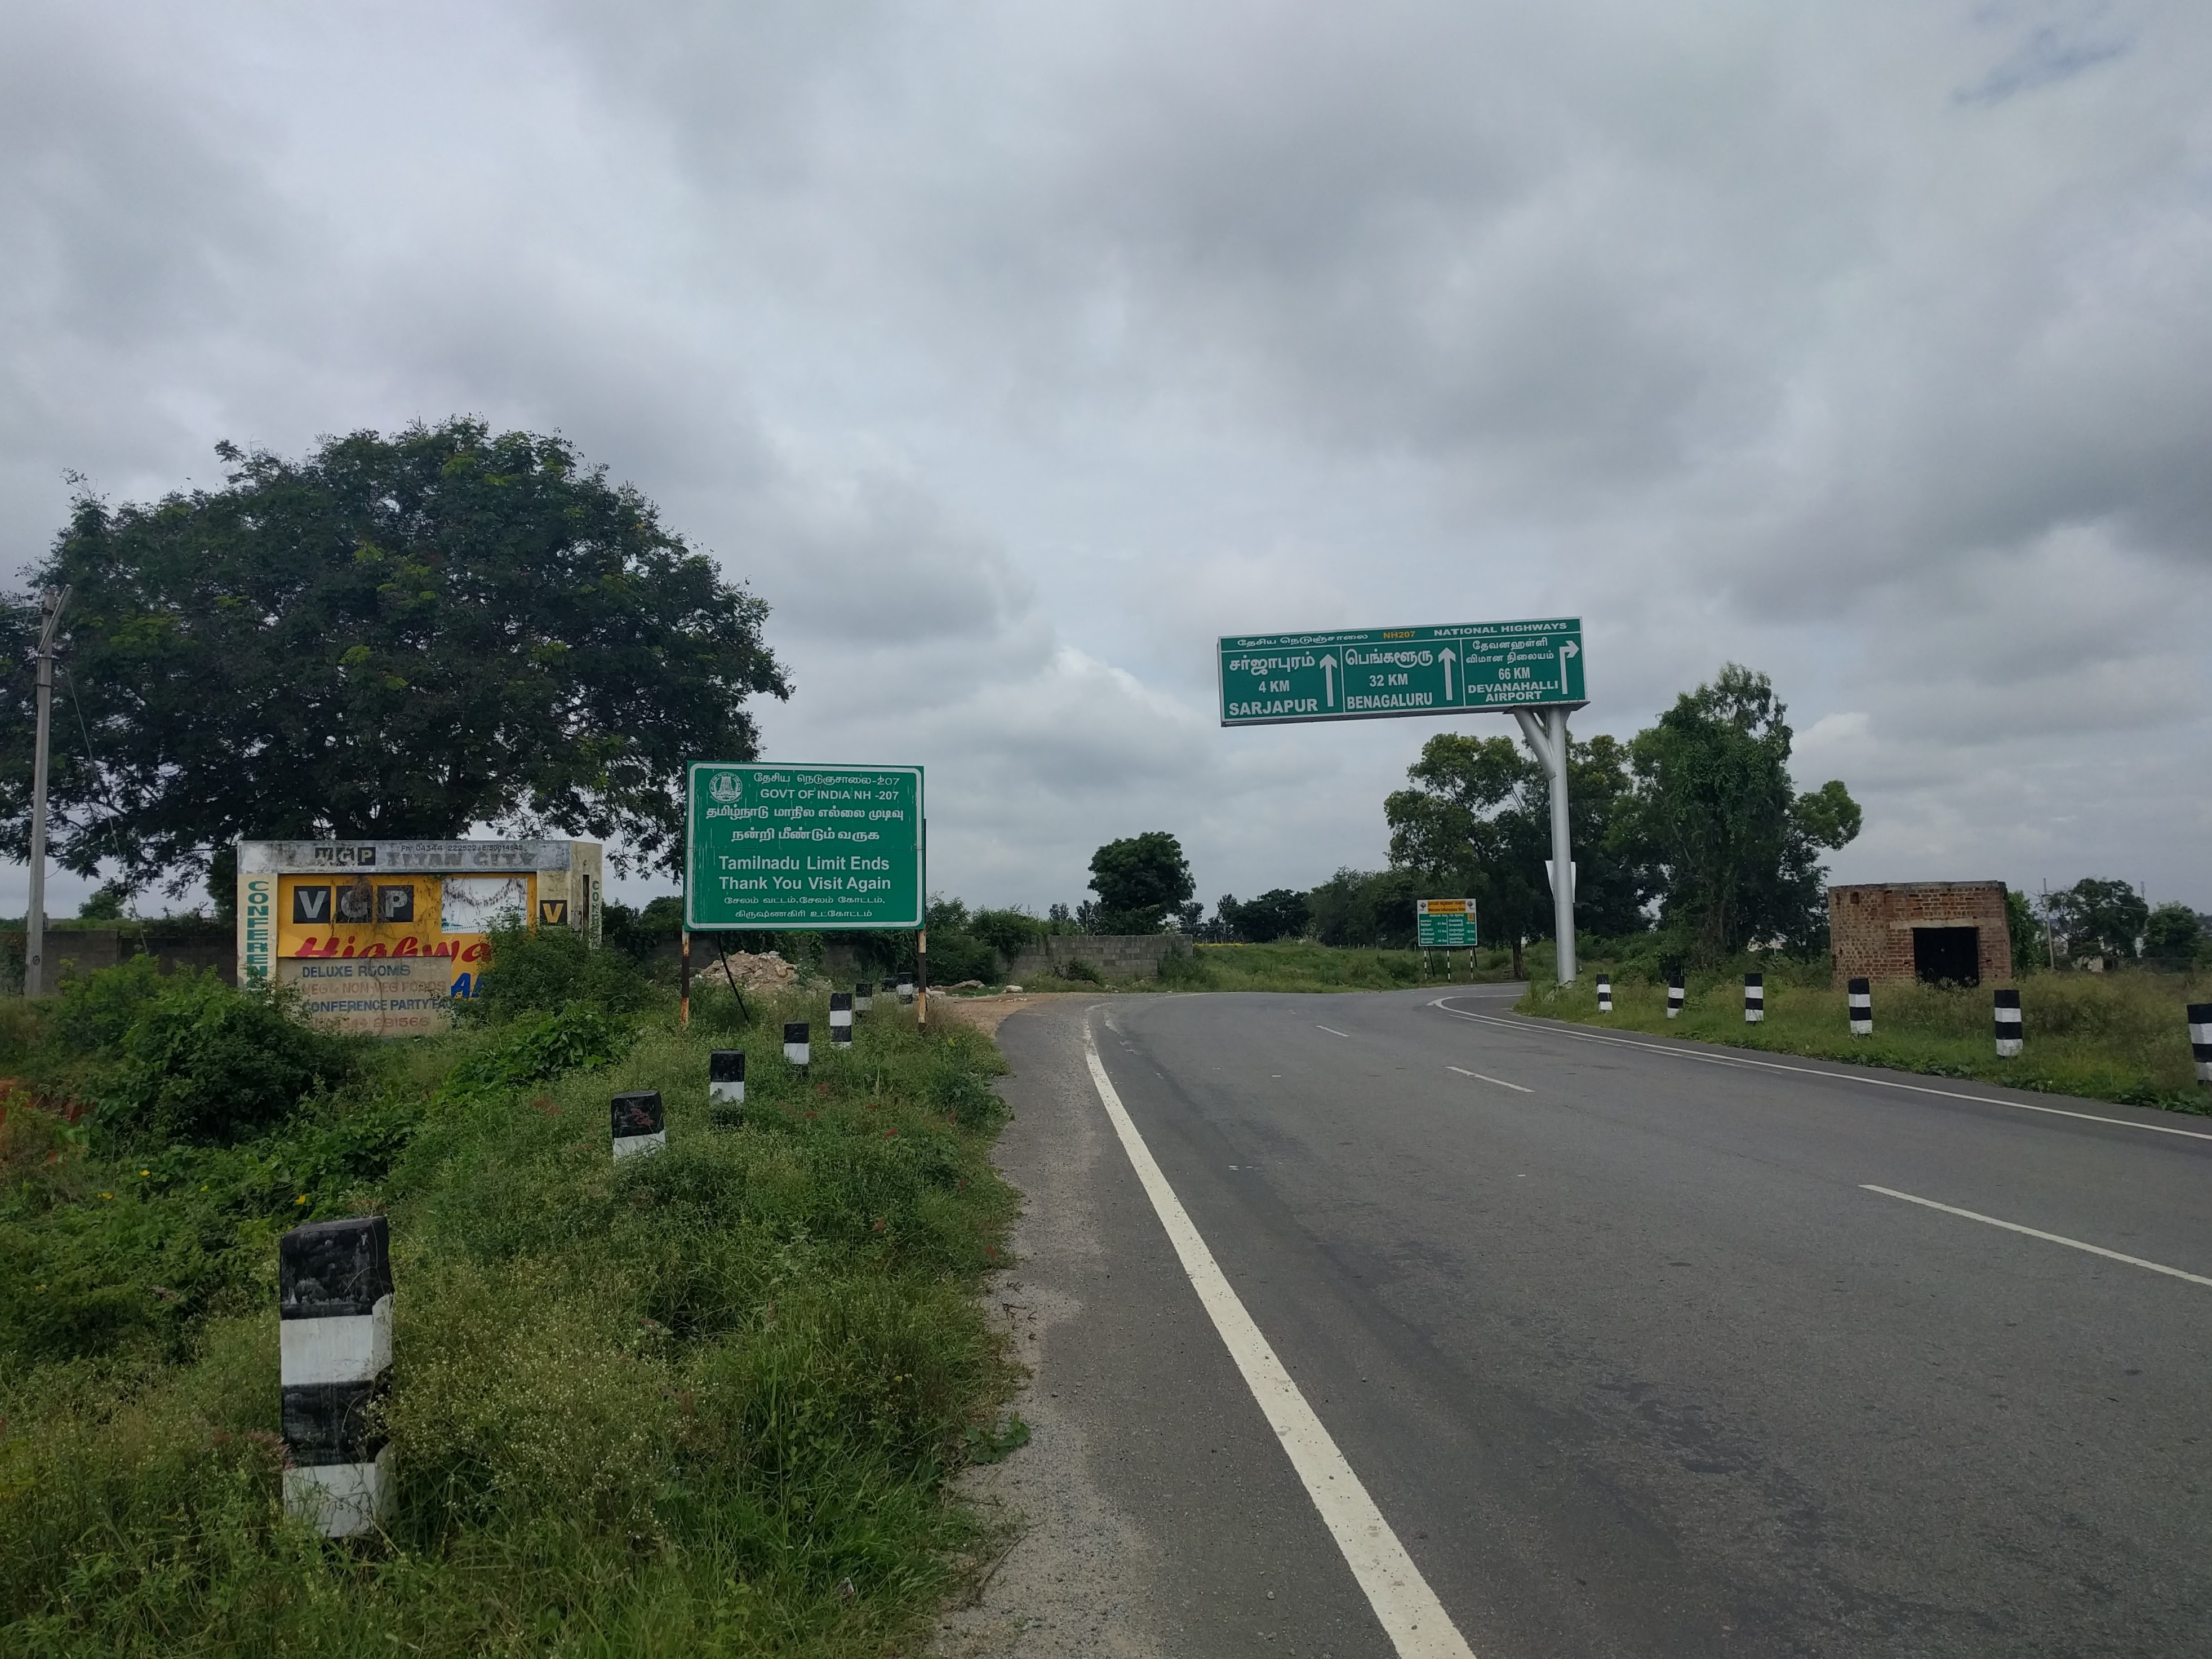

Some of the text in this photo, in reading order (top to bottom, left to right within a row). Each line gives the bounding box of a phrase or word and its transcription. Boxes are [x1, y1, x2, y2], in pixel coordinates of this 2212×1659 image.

[1383, 623, 1567, 639] NH207 NATIONAL HIGHWAYS
[1237, 638, 1277, 647] தேசிய
[1465, 654, 1503, 664] விமான
[1369, 673, 1408, 687] 32 KM
[1498, 667, 1530, 680] 66 KM
[1258, 680, 1290, 693] 4 KM
[1468, 680, 1558, 694] DEVANAHALLI
[1347, 692, 1433, 709] BENAGALURU
[1485, 691, 1542, 702] AIRPORT
[1229, 698, 1318, 716] SARJAPUR
[753, 772, 790, 784] தேசிய
[760, 788, 796, 799] GOVT
[798, 789, 815, 799] OF
[817, 790, 851, 800] INDIA
[854, 790, 871, 800] NH
[705, 803, 904, 821] தமிழ்நாடு மாநில எல்லை முடிவு
[731, 826, 880, 842] நன்றி மீண்டும் வருக
[718, 855, 890, 870] Tamilnadu Limit Ends
[718, 876, 891, 893] Thank You Visit Again
[303, 965, 410, 978] DELUXE ROOMS
[390, 999, 429, 1010] PARTY
[374, 1017, 429, 1027] 291566
